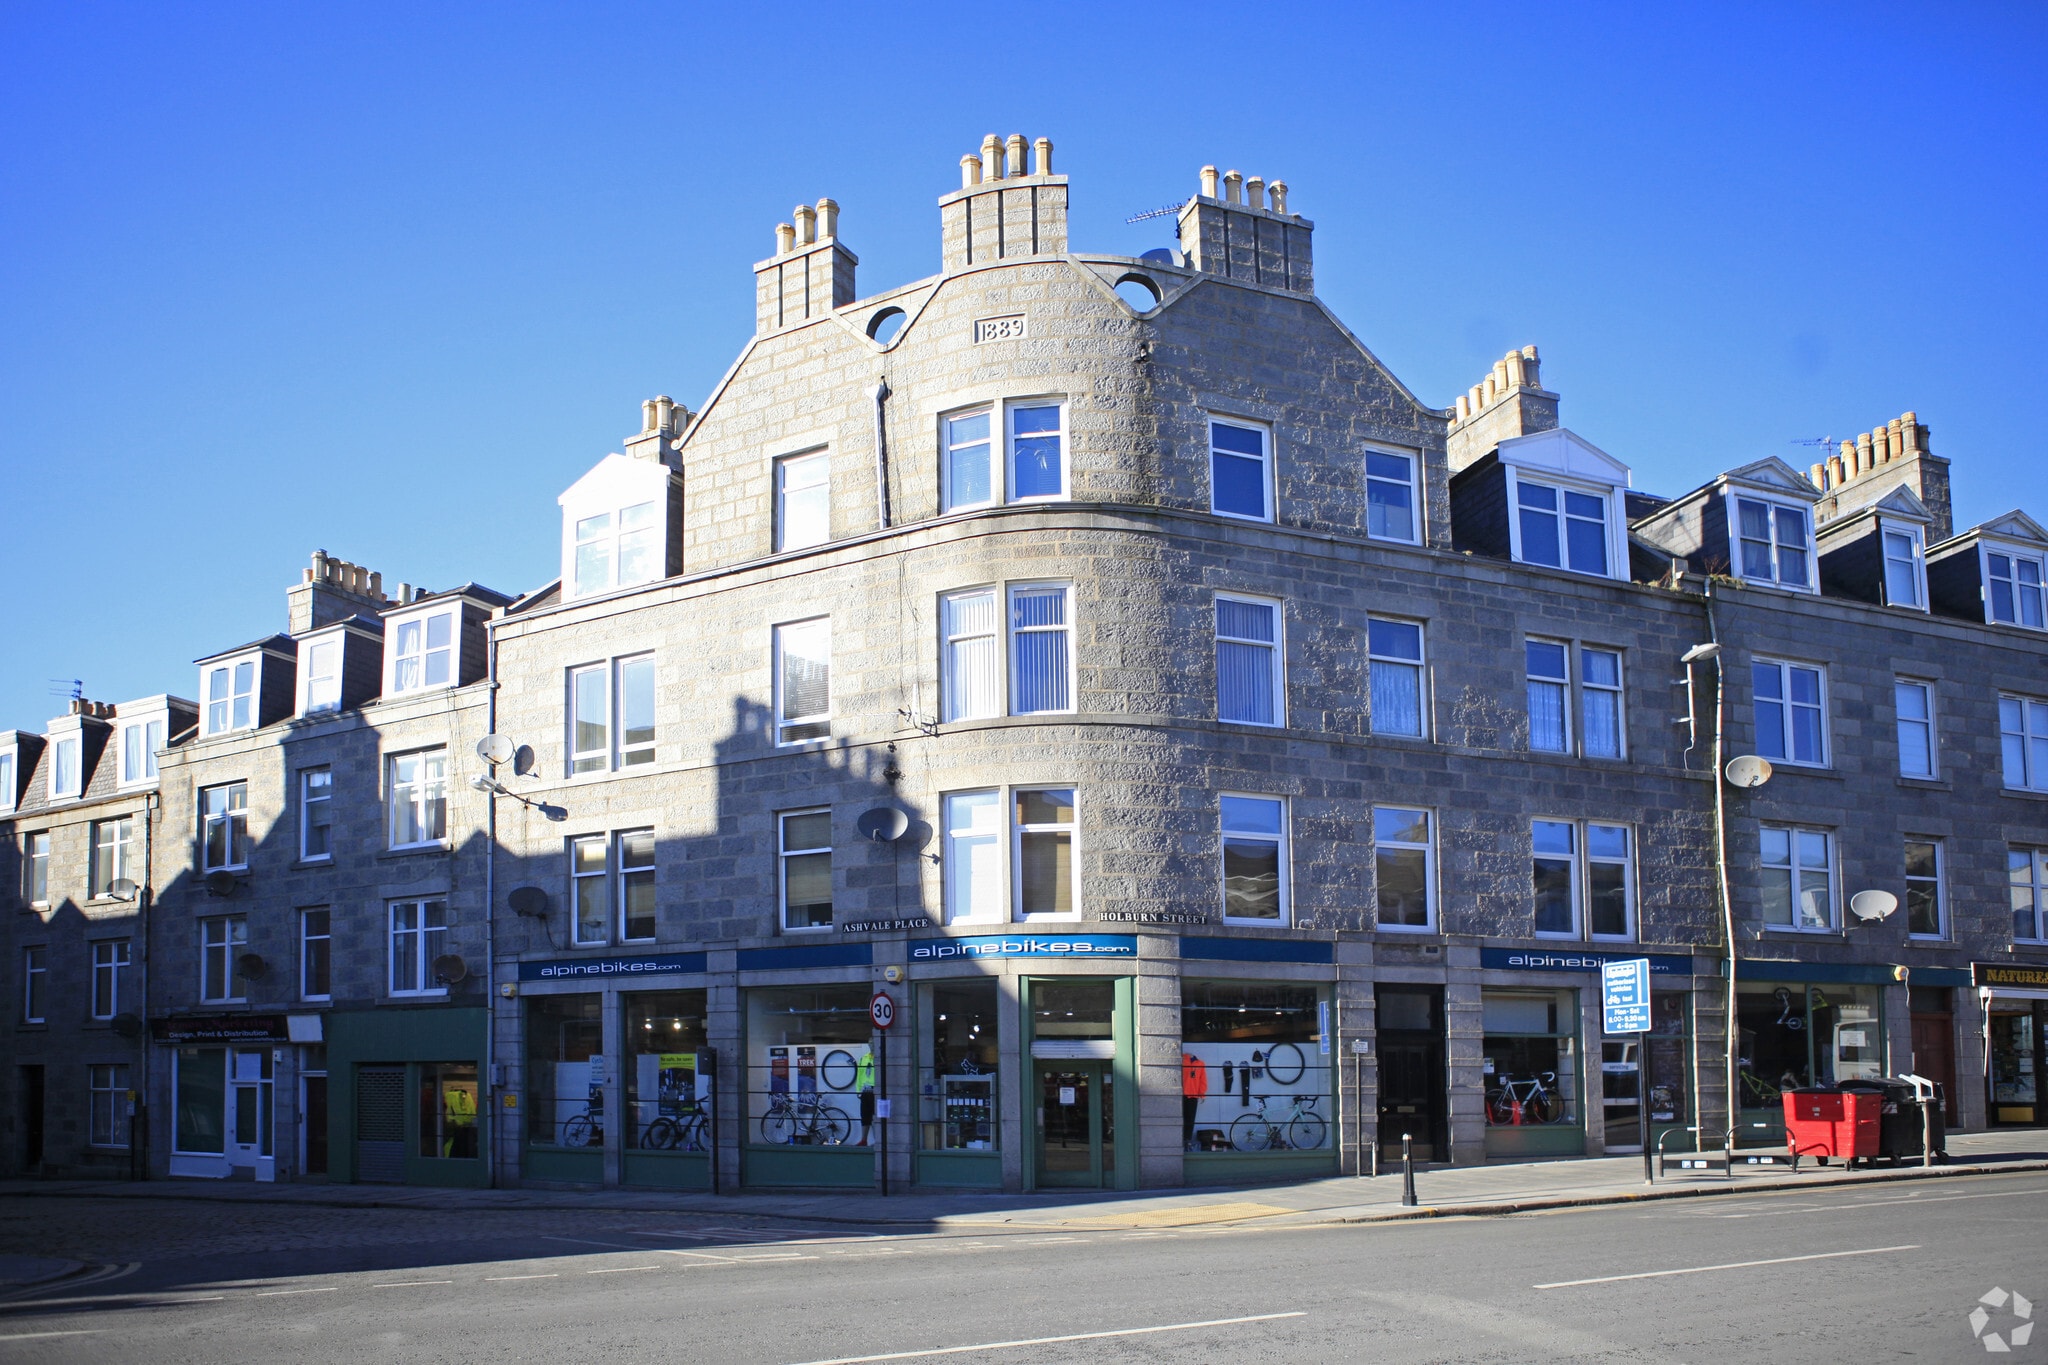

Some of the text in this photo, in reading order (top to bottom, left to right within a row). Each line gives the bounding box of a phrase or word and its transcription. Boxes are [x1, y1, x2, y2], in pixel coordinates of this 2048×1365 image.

[982, 319, 1024, 341] 1889
[843, 919, 928, 932] ASHVALE PLACE
[1100, 912, 1207, 924] HOLBURN STREET
[913, 938, 1130, 958] alpinebikes.com
[540, 961, 681, 977] alpinebikes.com
[874, 1003, 892, 1019] 30
[197, 1030, 215, 1038] Print
[224, 1029, 269, 1037] Distribution
